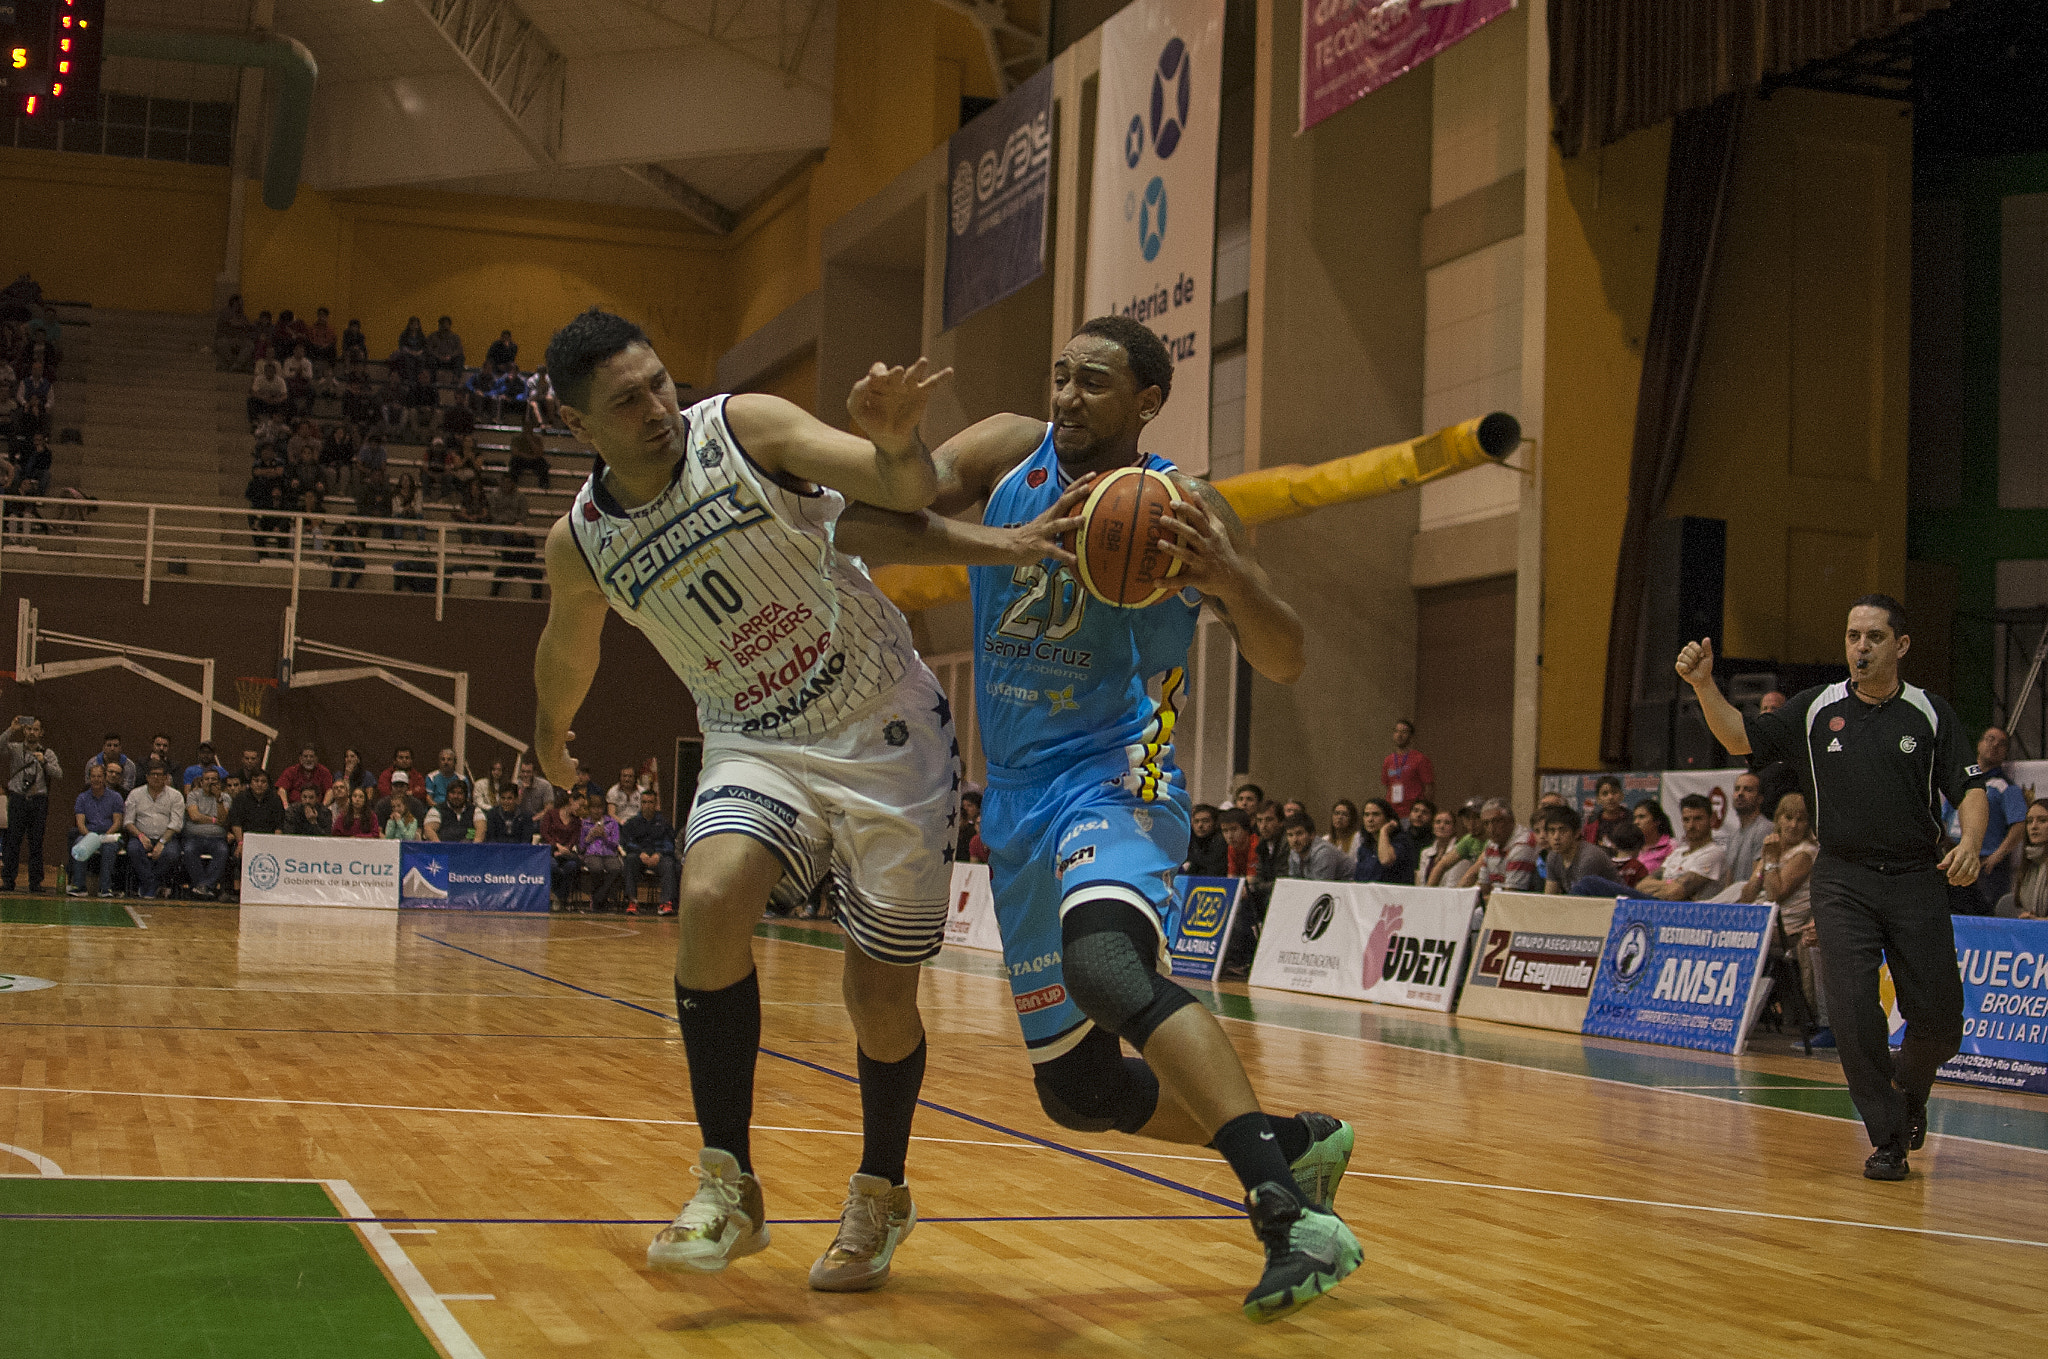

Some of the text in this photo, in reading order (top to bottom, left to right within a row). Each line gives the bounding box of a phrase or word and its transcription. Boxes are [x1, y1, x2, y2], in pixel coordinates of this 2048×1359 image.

[12, 47, 28, 69] 5
[1173, 271, 1194, 308] de
[610, 491, 768, 609] PEÑAROL
[686, 568, 743, 625] 10
[997, 563, 1087, 641] 20
[719, 601, 788, 653] LARREA
[733, 602, 812, 668] BROKERS
[734, 631, 831, 712] eskabe
[1034, 642, 1092, 668] Cruz
[728, 788, 795, 825] VALASTRO
[283, 877, 394, 889] Gobierno de la provincia
[284, 858, 394, 876] Santa Cruz
[448, 872, 545, 885] Banco Santa Cruz
[1174, 937, 1218, 956] ALARMAS
[1480, 929, 1513, 975] 2
[1514, 935, 1600, 953] GRUPO ASEGURADOR
[1659, 926, 1713, 948] RESTAURANT
[1012, 951, 1062, 977] TAQSA
[1382, 933, 1457, 988] UDEM
[1521, 959, 1594, 991] segunda
[1652, 957, 1739, 1007] AMSA
[2010, 1061, 2047, 1076] Gallegos
